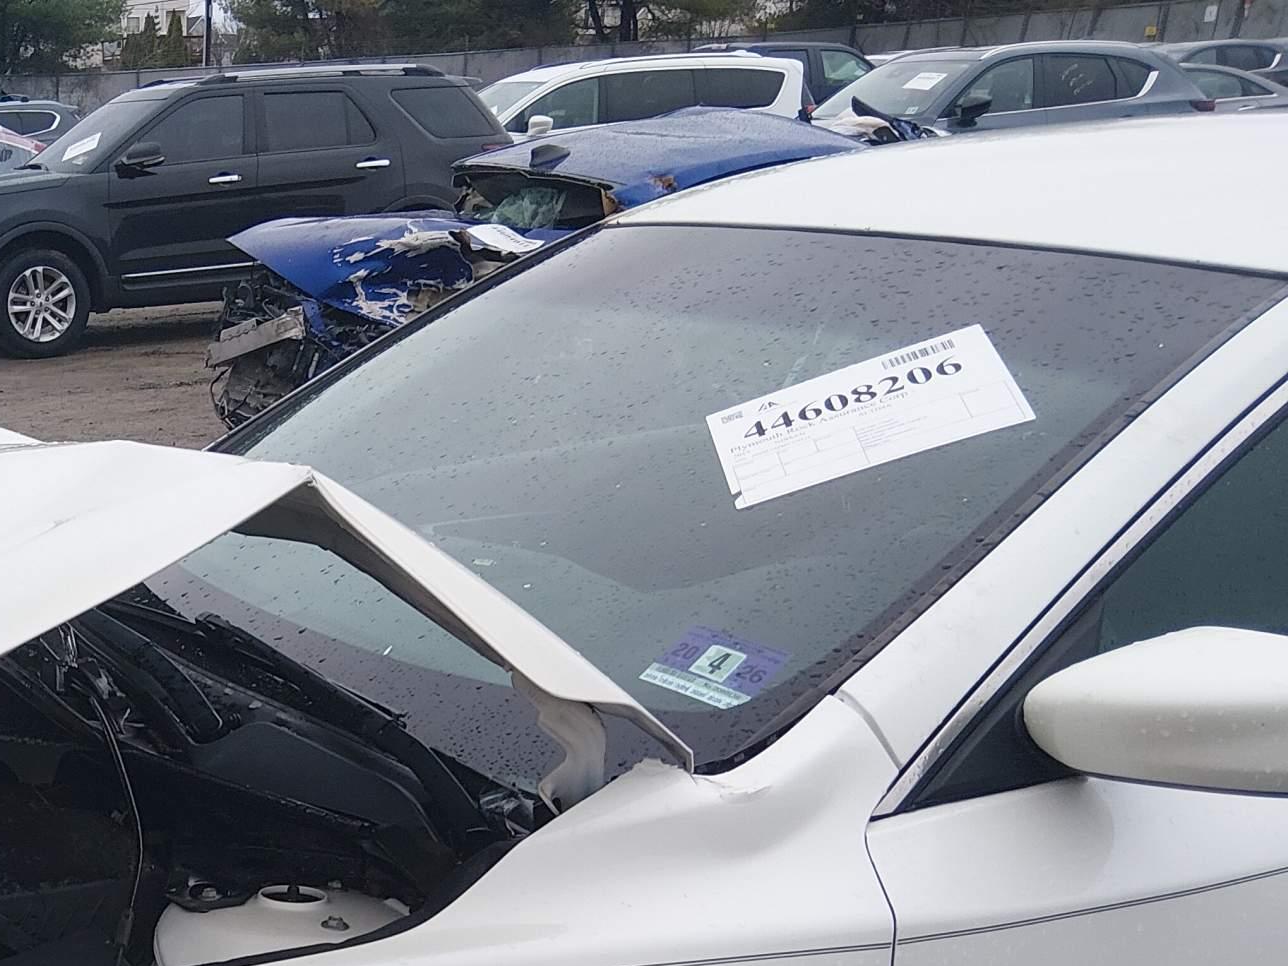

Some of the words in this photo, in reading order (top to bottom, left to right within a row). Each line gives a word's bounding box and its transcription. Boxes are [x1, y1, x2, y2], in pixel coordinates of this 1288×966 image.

[743, 354, 963, 438] 44608206
[673, 642, 700, 661] 20
[708, 652, 732, 674] 4
[738, 664, 768, 684] 26
